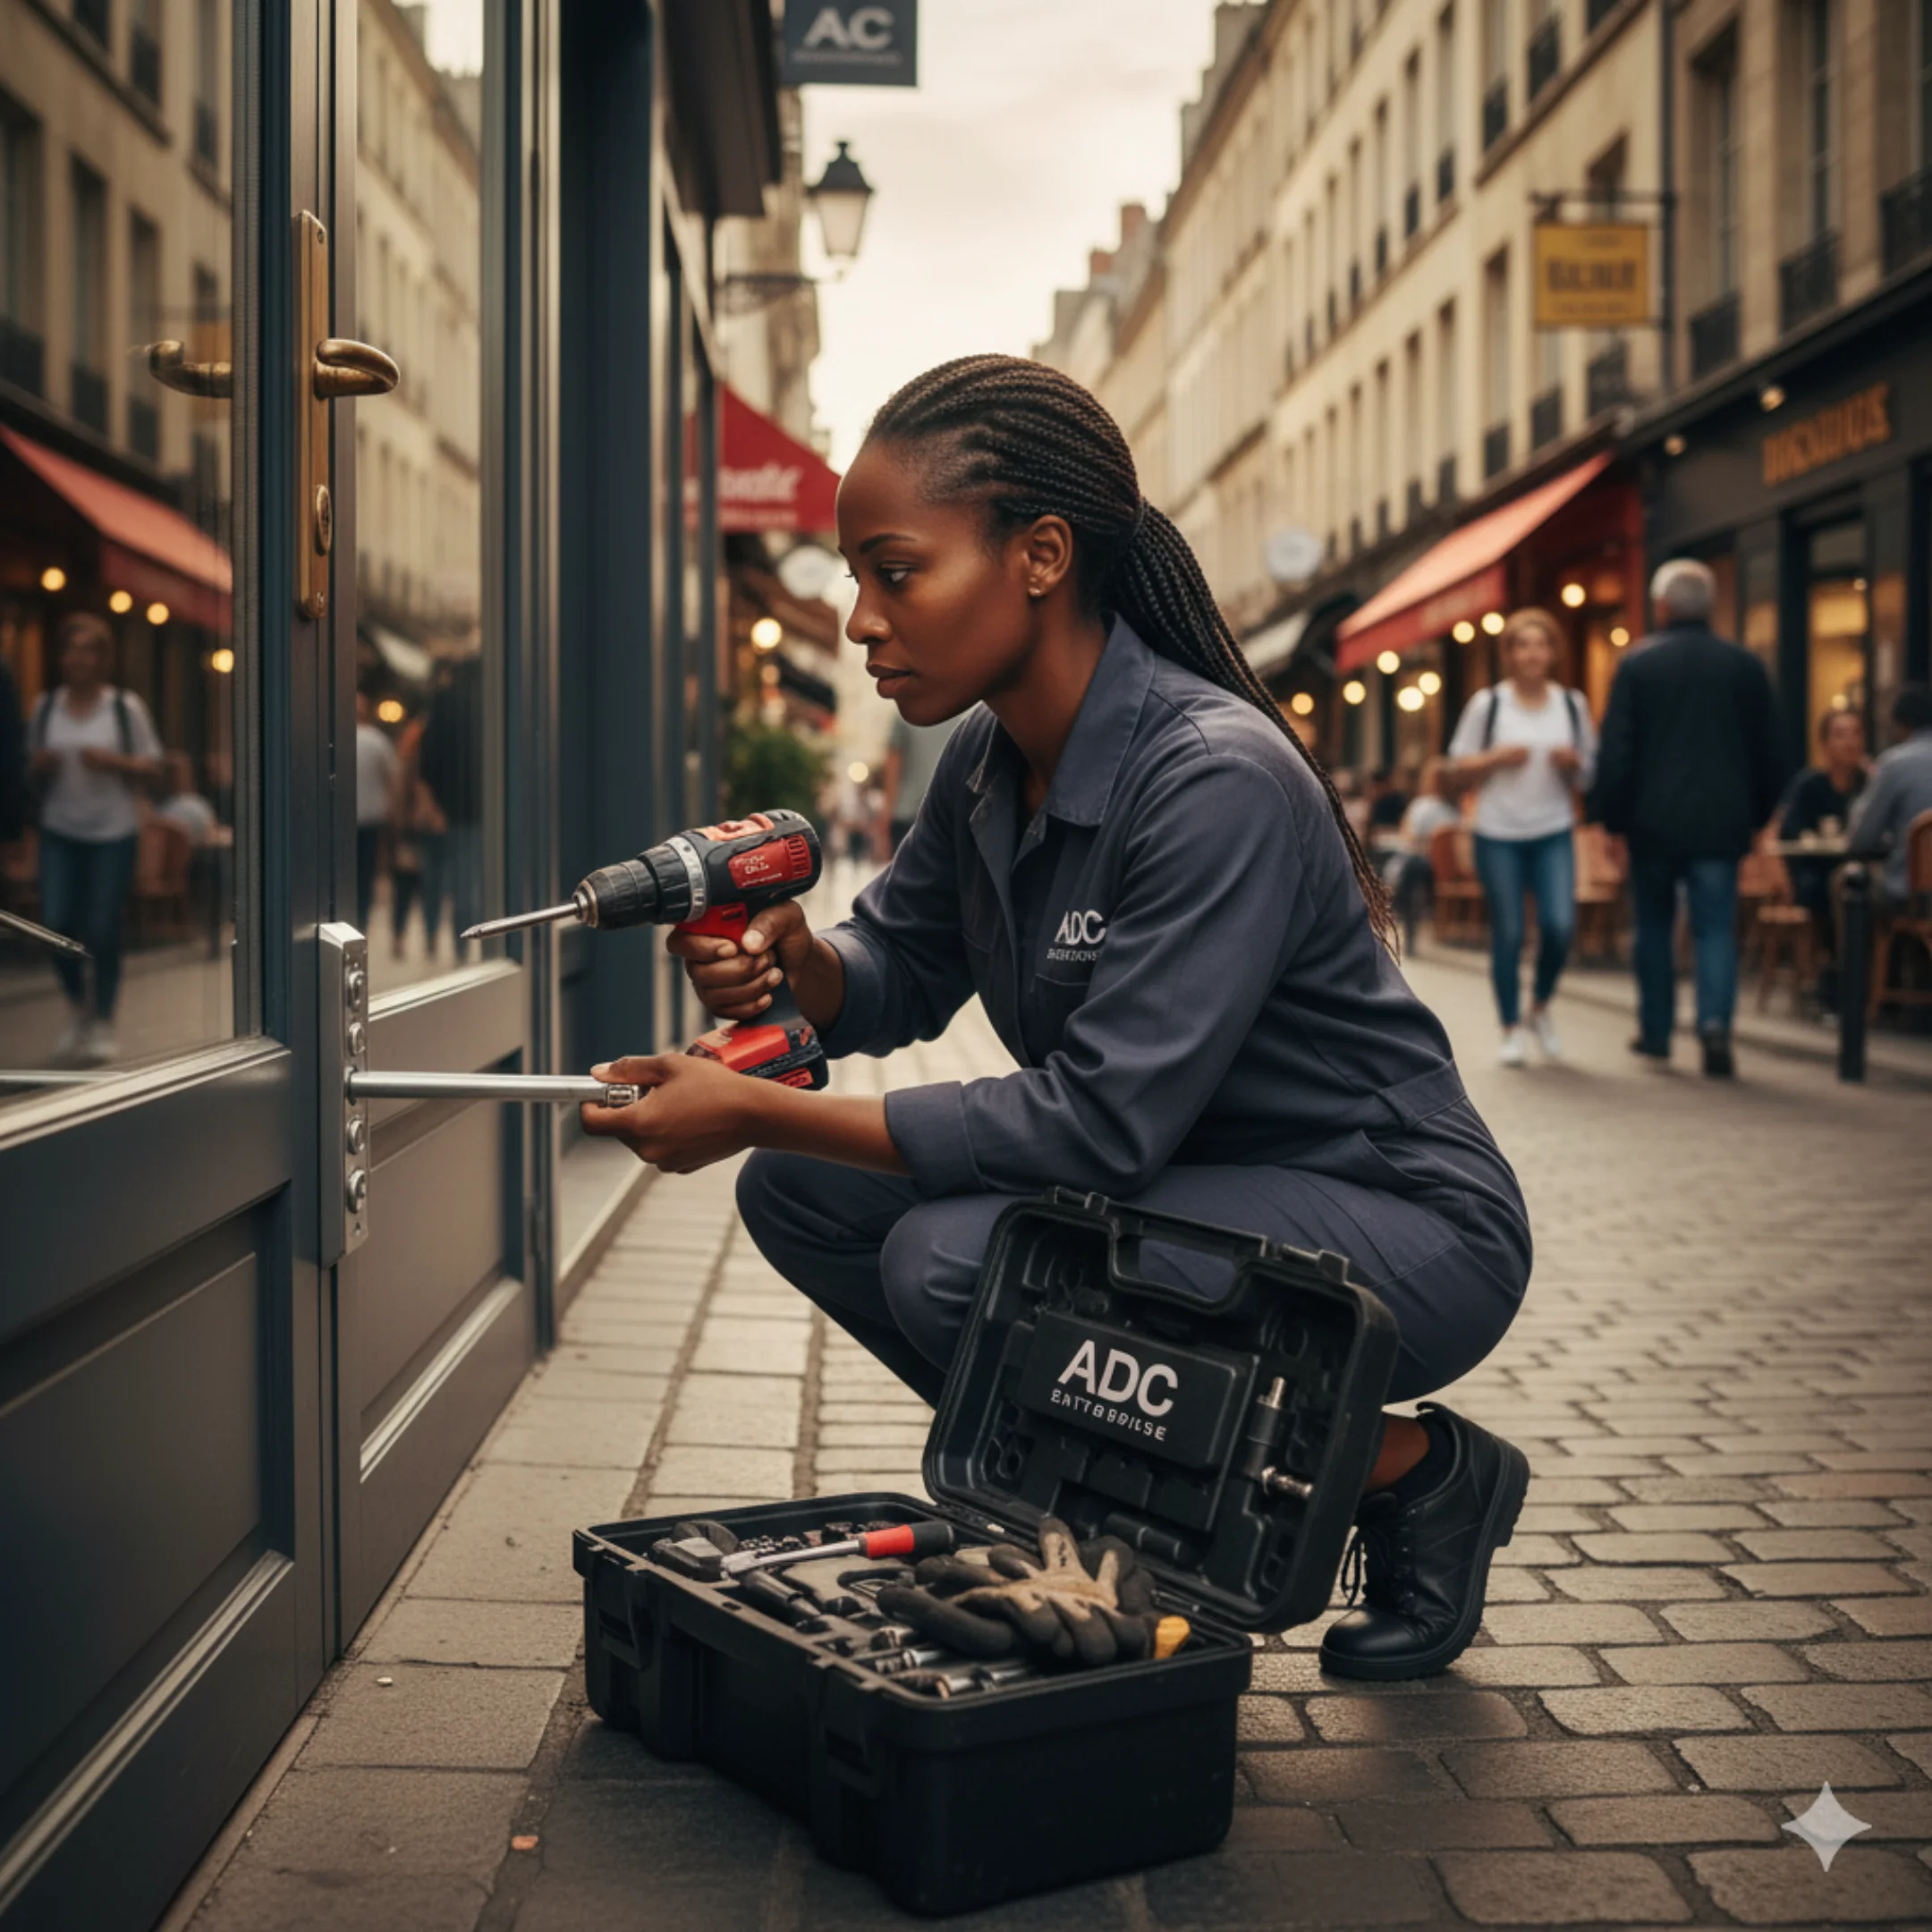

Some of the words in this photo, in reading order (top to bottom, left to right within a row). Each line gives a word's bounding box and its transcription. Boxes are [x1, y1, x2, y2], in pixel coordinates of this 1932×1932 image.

[803, 6, 894, 50] AC
[1055, 909, 1106, 945] ADC
[1057, 1339, 1178, 1417] ADC
